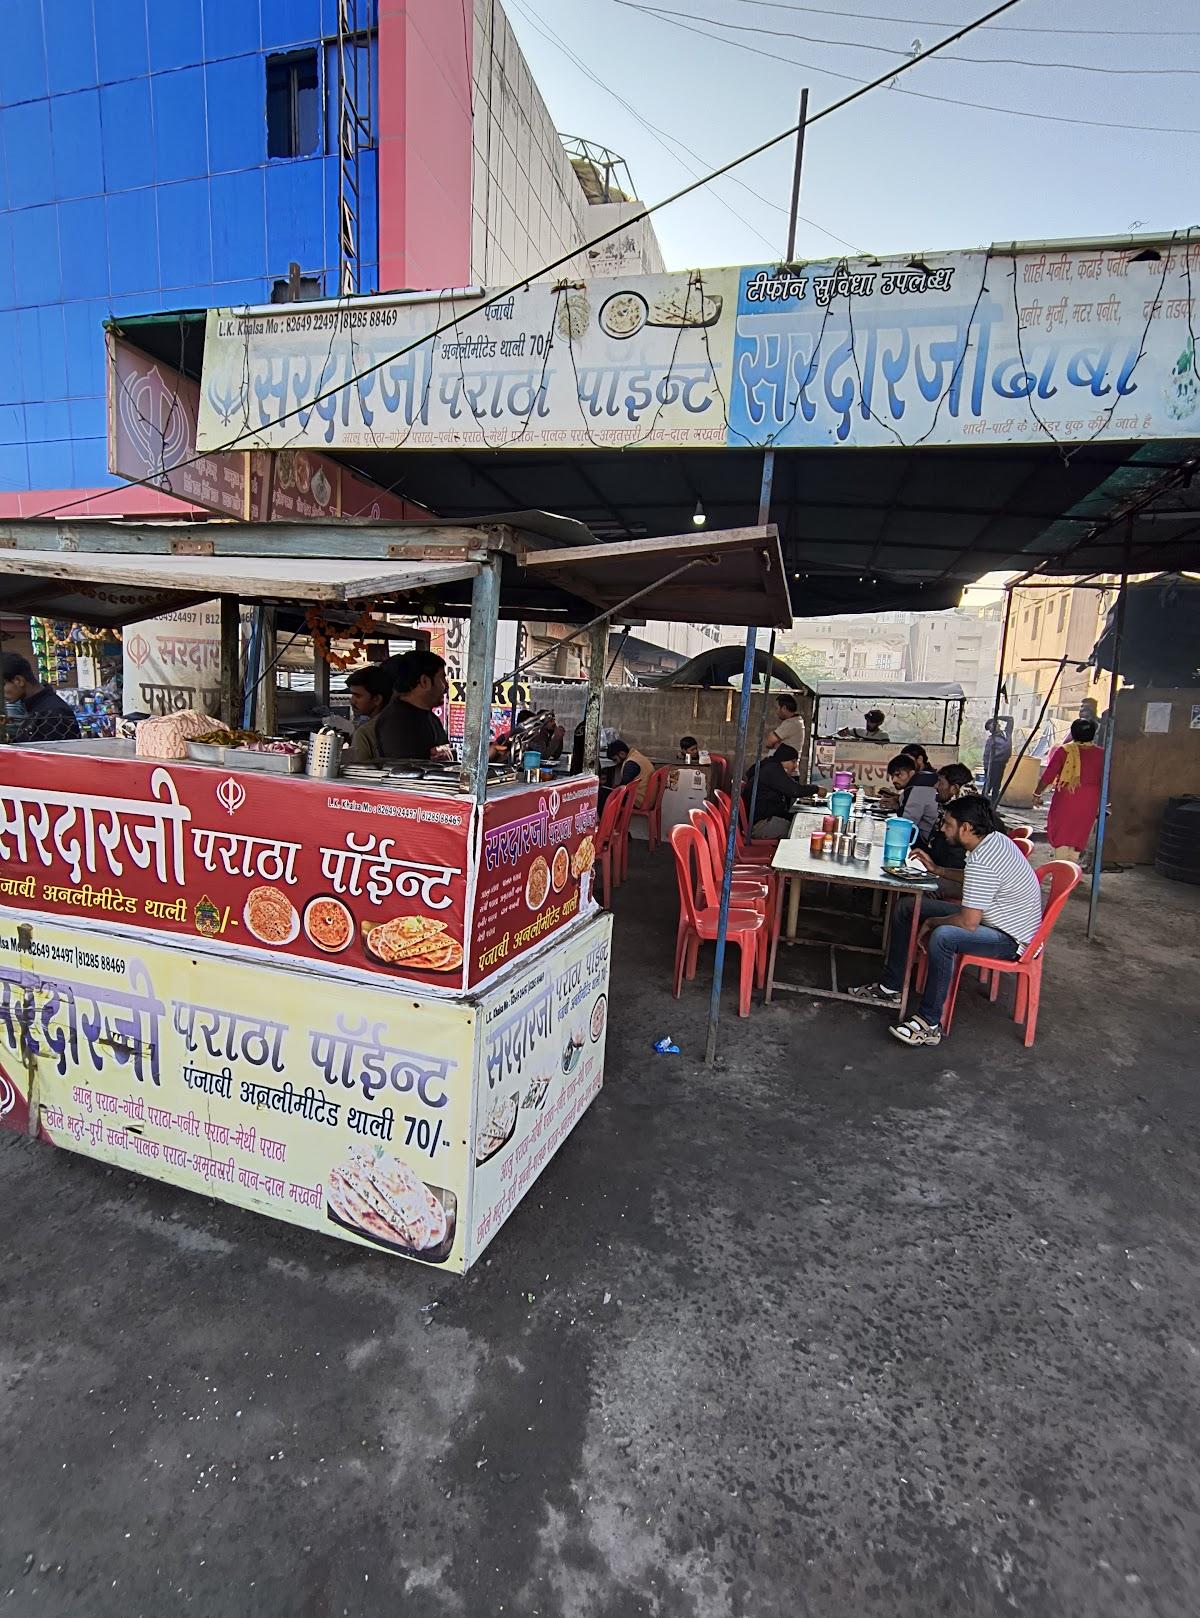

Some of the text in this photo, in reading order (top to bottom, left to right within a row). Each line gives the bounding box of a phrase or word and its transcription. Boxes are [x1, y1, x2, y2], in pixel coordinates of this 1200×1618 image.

[812, 268, 876, 306] सुविधा
[881, 267, 955, 294] उपलब्ध
[1024, 254, 1046, 283] शाही
[1180, 244, 1200, 274] पनी
[218, 322, 235, 336] L.K.
[237, 318, 264, 334] Khalsa
[265, 318, 279, 333] Mo
[286, 314, 311, 332] 82649
[369, 309, 397, 328] 88469
[1073, 303, 1093, 323] मटर
[441, 334, 497, 359] अनलीमीटेड
[500, 332, 526, 357] थाली
[990, 336, 1139, 400] ढाबा
[438, 367, 557, 419] पराठा
[1065, 419, 1085, 435] बुक
[1115, 412, 1140, 430] जाते
[485, 796, 549, 870] सरदारजी
[191, 828, 302, 885] पराठा
[319, 832, 462, 910] पॉईन्ट
[0, 875, 36, 898] जाबी
[43, 884, 138, 914] अनलीमीटेड
[145, 898, 187, 922] थाली
[51, 945, 73, 963] 24497
[101, 954, 125, 974] 88469
[478, 931, 510, 972] पंजाबी
[513, 904, 561, 950] अनलीमीटेड
[486, 966, 555, 1090] सरदारजी
[556, 958, 583, 1002] पराठा
[172, 1000, 289, 1072] पराठा
[309, 1012, 457, 1108] पॉईन्ट
[96, 1093, 144, 1121] पराठा-गोबी
[148, 1106, 200, 1137] पराठा-पनीर
[204, 1122, 256, 1153] पराठा-मेथी
[260, 1138, 286, 1162] पराठा
[183, 1060, 450, 1158] पंजाबी अनलीमीटेड थाली 70/-
[46, 1105, 64, 1129] छोले
[239, 1167, 286, 1198] नान-दाल
[289, 1183, 323, 1209] मखनी
